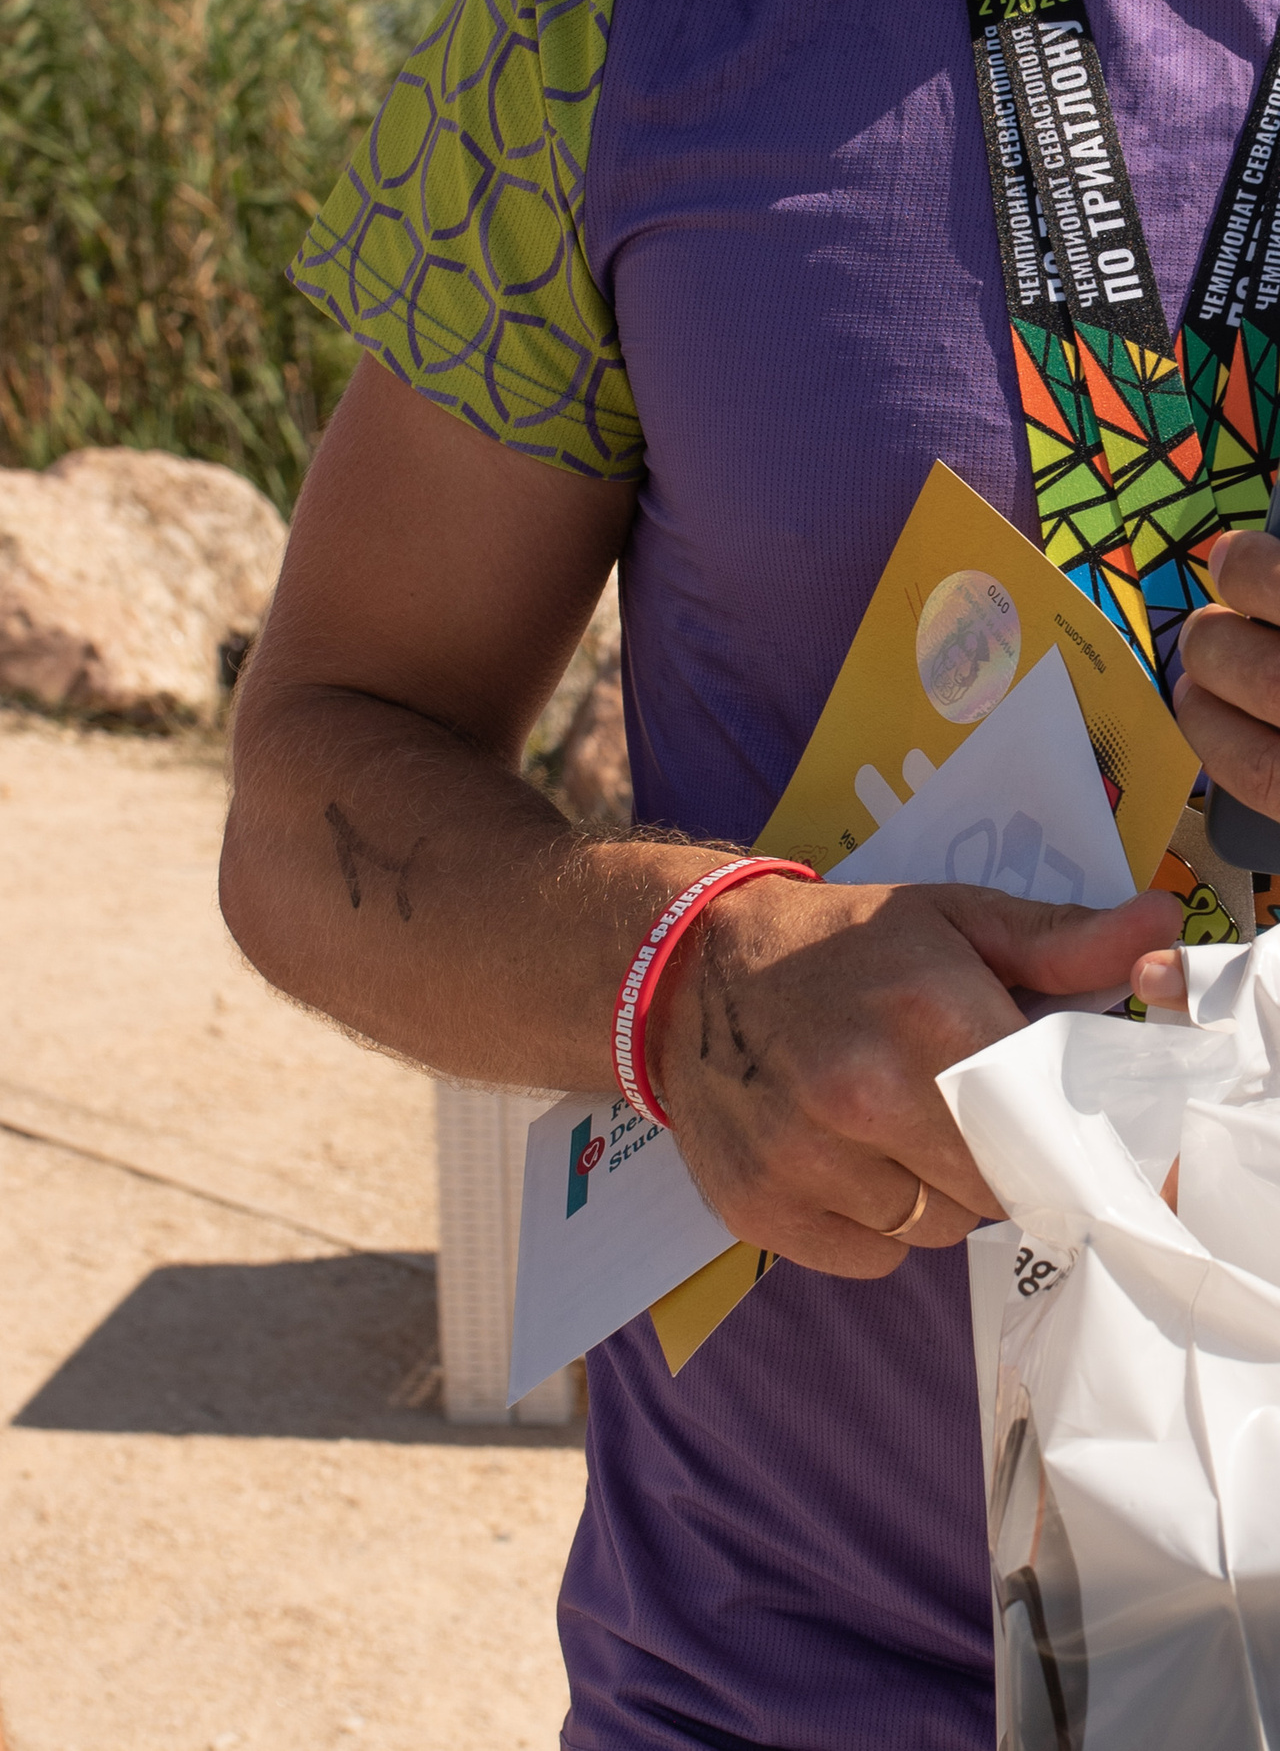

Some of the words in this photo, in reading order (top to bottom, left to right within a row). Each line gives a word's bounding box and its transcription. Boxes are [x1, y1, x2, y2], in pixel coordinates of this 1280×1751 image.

[1011, 25, 1065, 169] СЕВАСТОПОЛЯ
[1037, 20, 1126, 238] ТРИАТЛОНУ
[1004, 175, 1041, 305] ЧЕМПИОНАТ
[1048, 177, 1099, 308] ЧЕМПИОНАТ
[1097, 248, 1144, 303] ПО
[1199, 188, 1258, 320] ЧЕМПИОНАТ
[987, 584, 1010, 614] 0170
[1053, 613, 1106, 674] miyagi.com.ru
